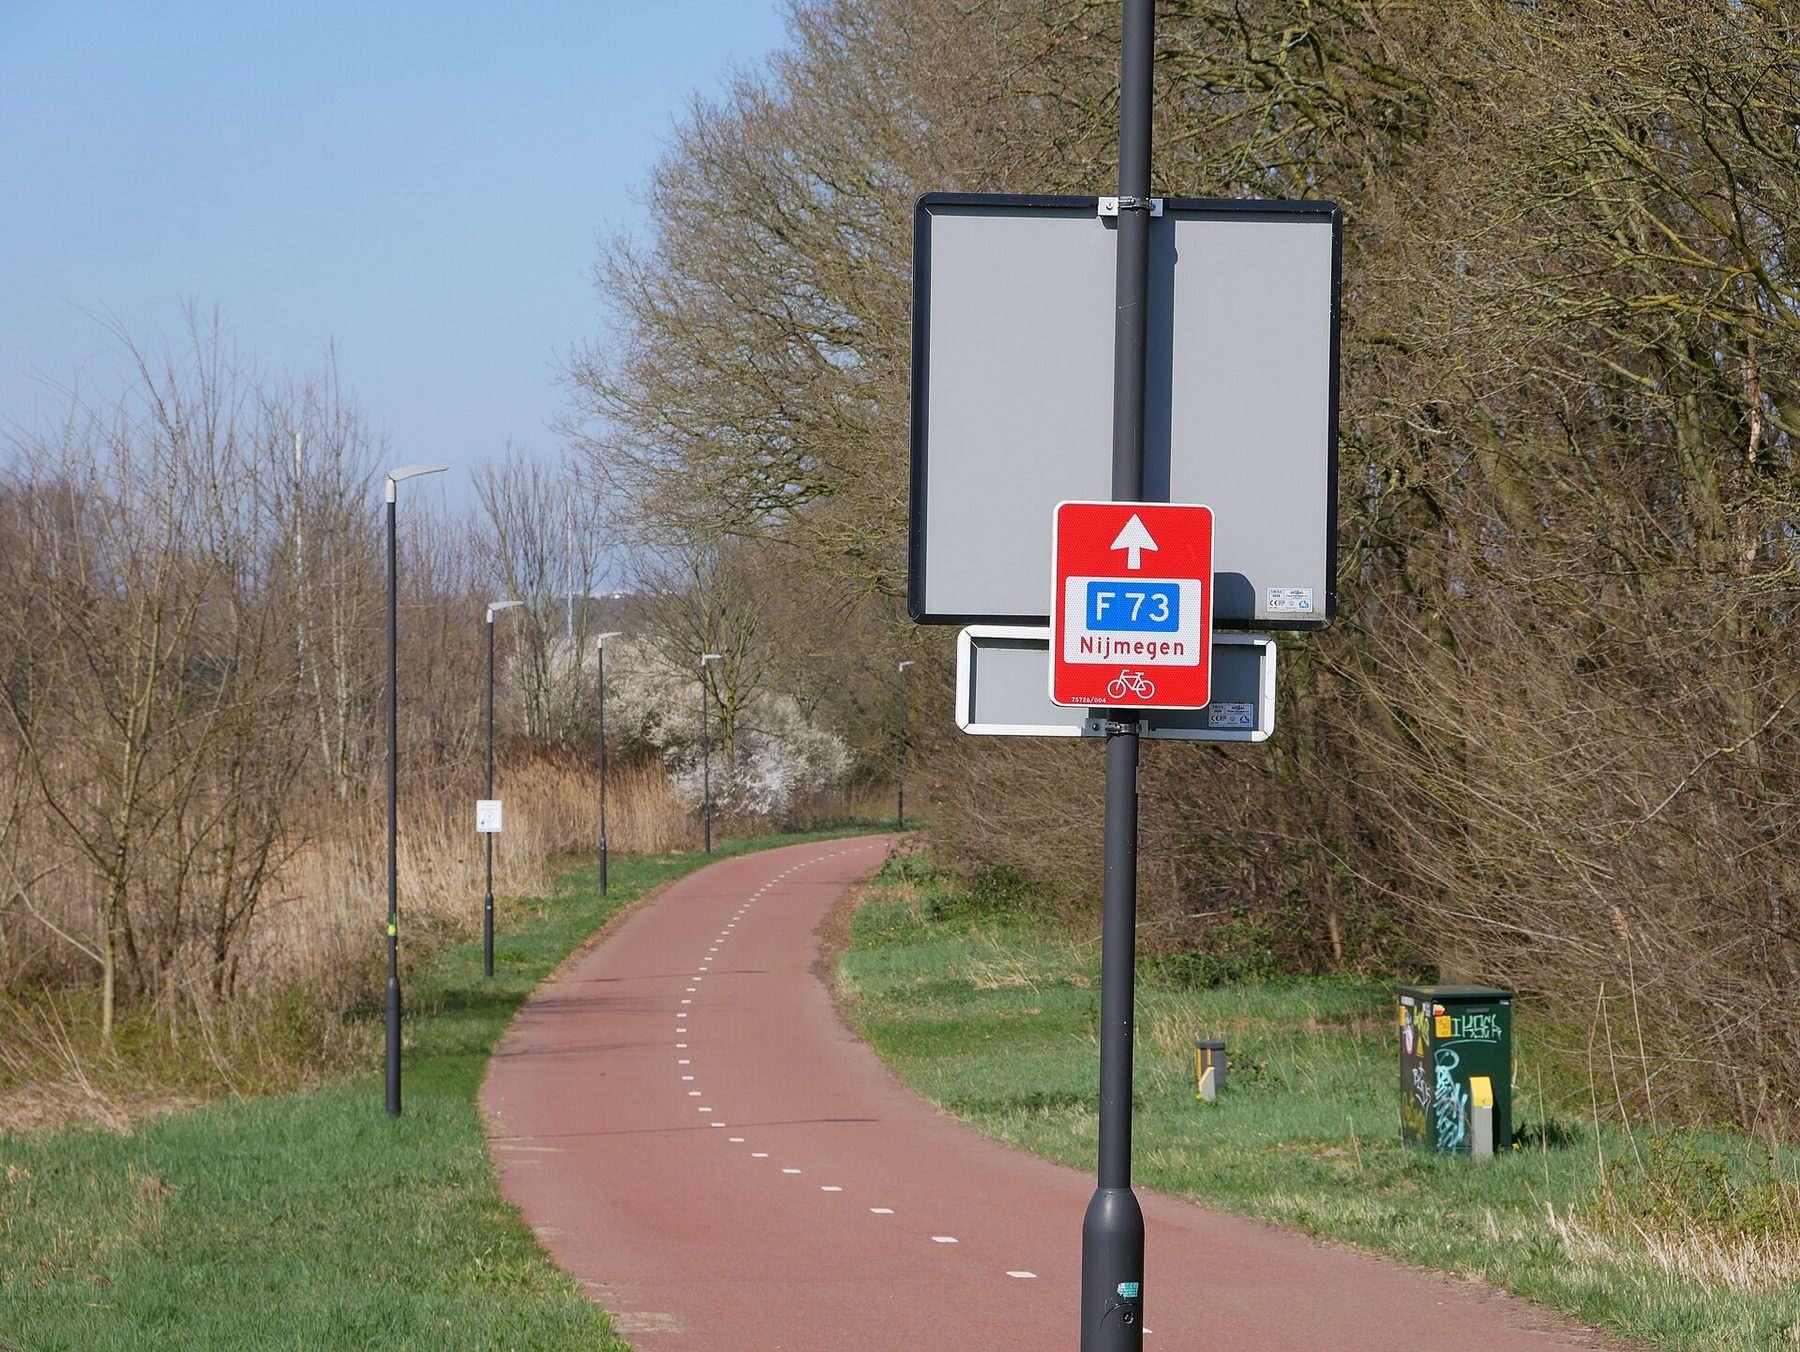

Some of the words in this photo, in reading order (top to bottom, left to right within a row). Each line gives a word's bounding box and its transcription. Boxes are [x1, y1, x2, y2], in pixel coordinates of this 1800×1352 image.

[1096, 592, 1116, 620] F
[1125, 592, 1170, 622] 73
[1080, 636, 1184, 660] Nijmegen
